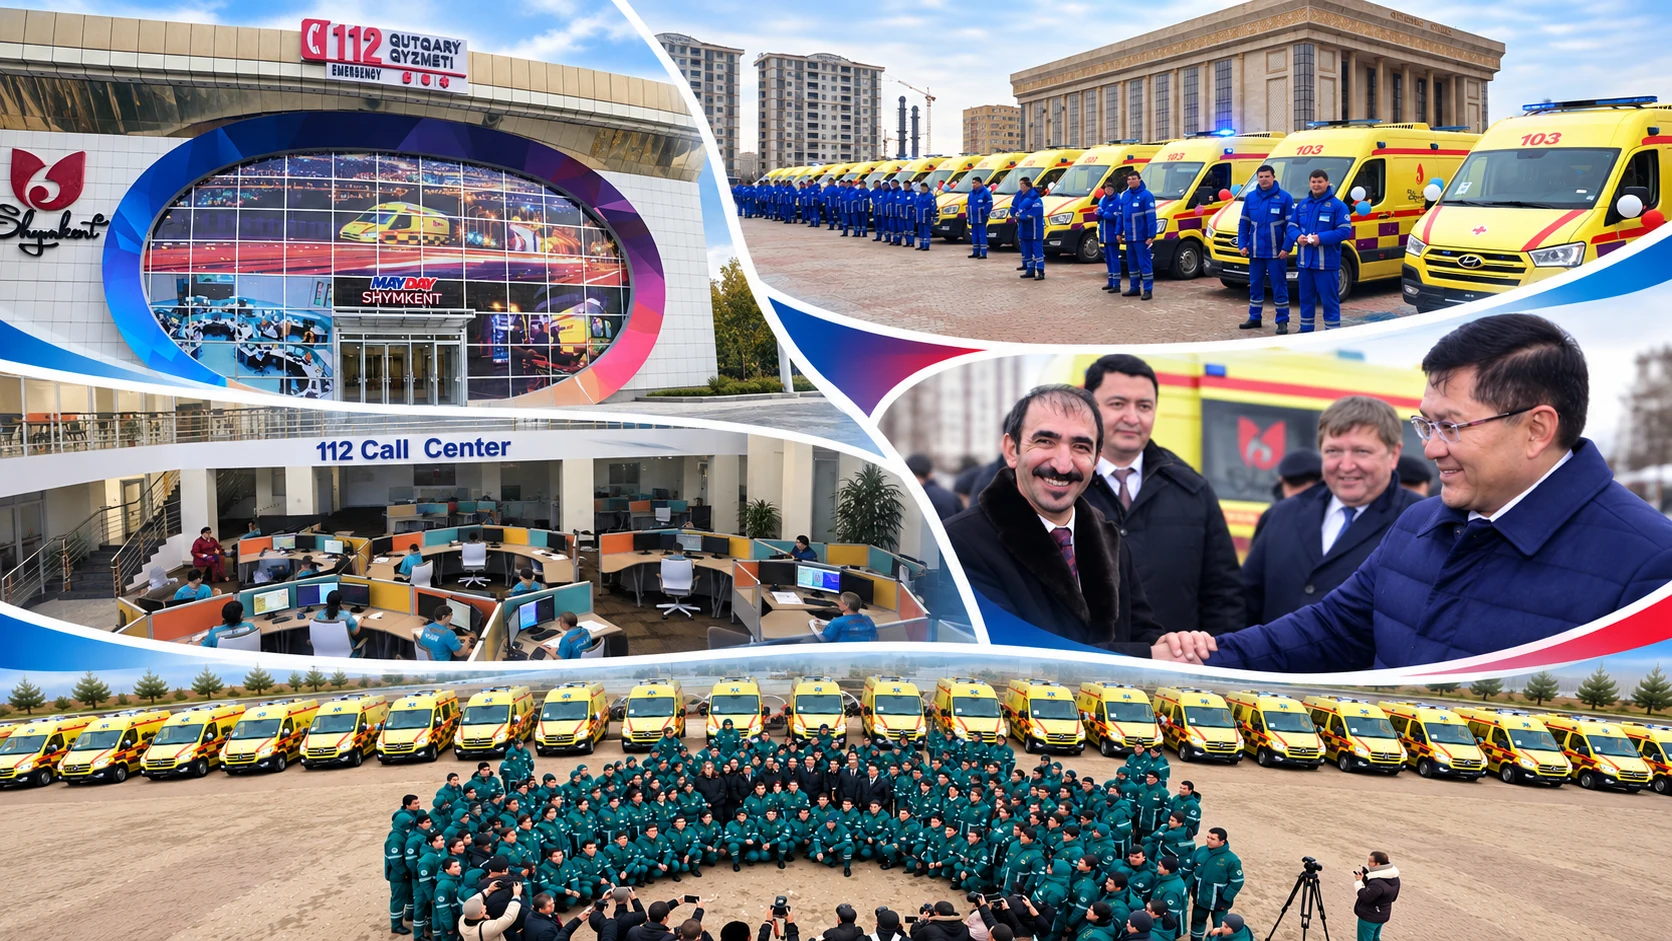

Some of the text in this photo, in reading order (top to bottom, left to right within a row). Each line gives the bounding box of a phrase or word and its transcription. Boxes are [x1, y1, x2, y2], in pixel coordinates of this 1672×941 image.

[333, 24, 382, 64] 112
[389, 48, 454, 69] QYZMETI
[332, 64, 382, 81] EMERGENCY
[1521, 132, 1562, 146] 103
[1296, 144, 1324, 156] 103
[370, 276, 438, 291] MAYDAY
[362, 291, 443, 305] SHYMKENT
[316, 437, 511, 461] 112 Call Center
